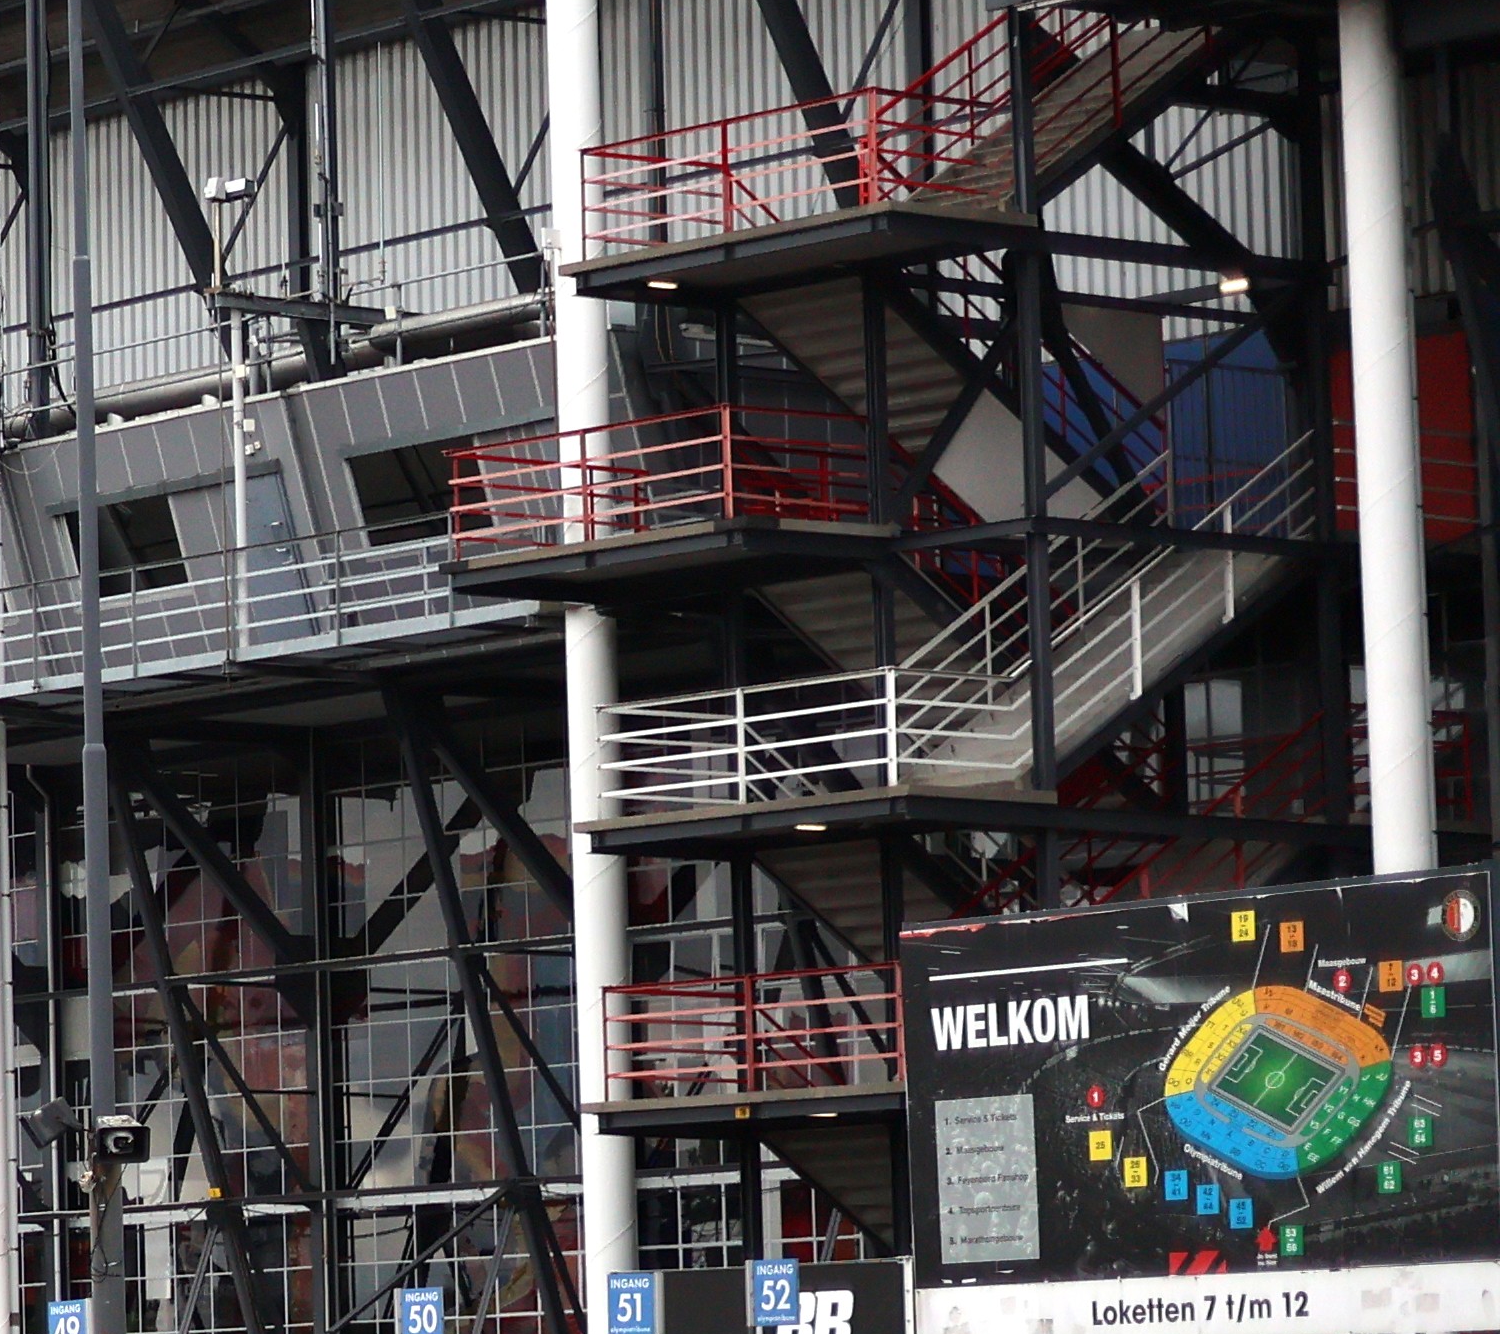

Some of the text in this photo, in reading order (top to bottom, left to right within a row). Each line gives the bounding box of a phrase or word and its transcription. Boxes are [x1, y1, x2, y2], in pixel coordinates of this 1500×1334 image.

[1411, 966, 1439, 979] 3 4
[1339, 975, 1347, 986] 2
[930, 995, 1090, 1051] WELKOM
[1413, 1050, 1442, 1062] 3 5
[1093, 1092, 1099, 1102] 1
[756, 1265, 793, 1275] INGANG
[610, 1279, 650, 1289] INGANG
[405, 1292, 439, 1302] INGANG
[761, 1279, 790, 1311] 52
[50, 1304, 81, 1315] INGANG
[616, 1292, 642, 1322] 51
[1092, 1291, 1309, 1326] Loketten 7 t/m 12
[408, 1304, 438, 1334] 50
